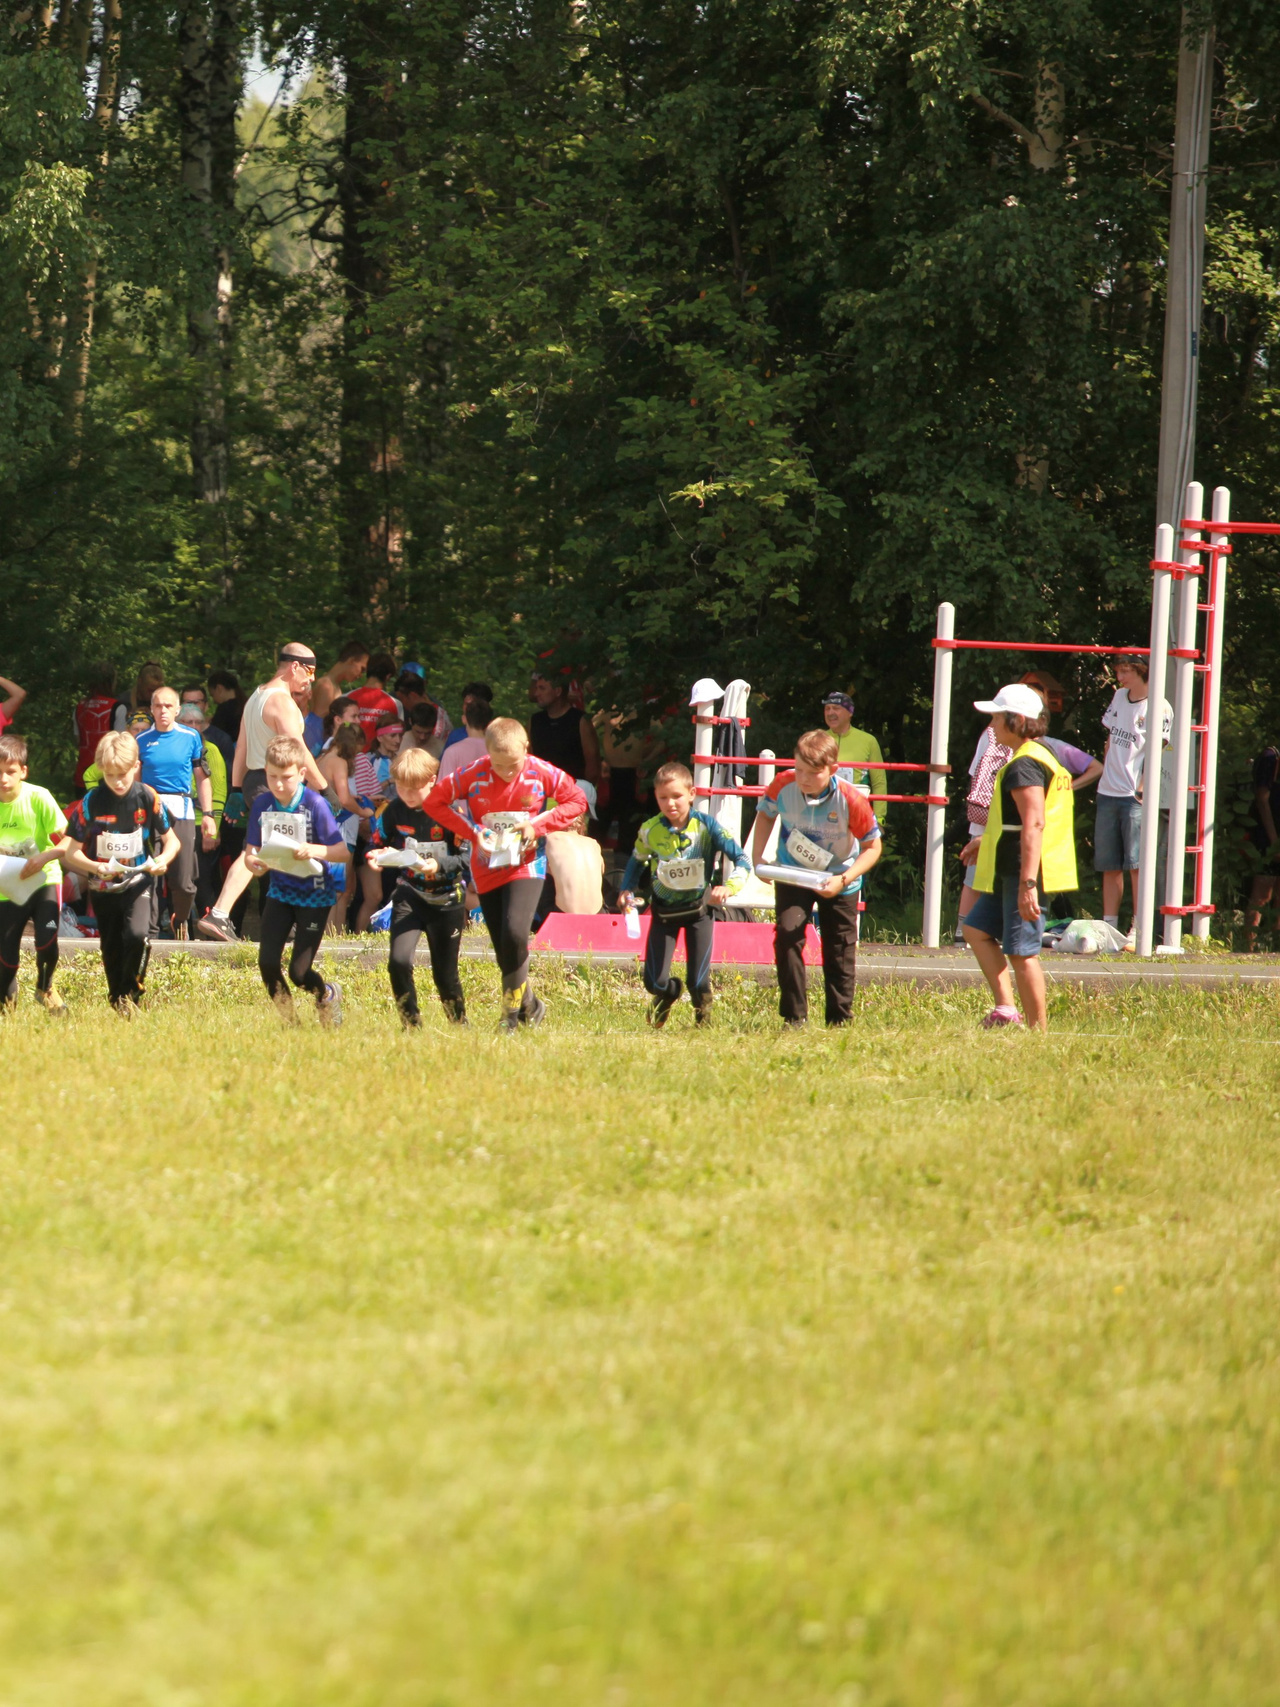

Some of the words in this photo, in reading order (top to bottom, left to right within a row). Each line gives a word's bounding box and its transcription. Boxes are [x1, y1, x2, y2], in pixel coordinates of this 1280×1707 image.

[273, 823, 294, 836] 656
[106, 842, 129, 851] 655
[796, 844, 816, 863] 658
[669, 866, 690, 879] 637
